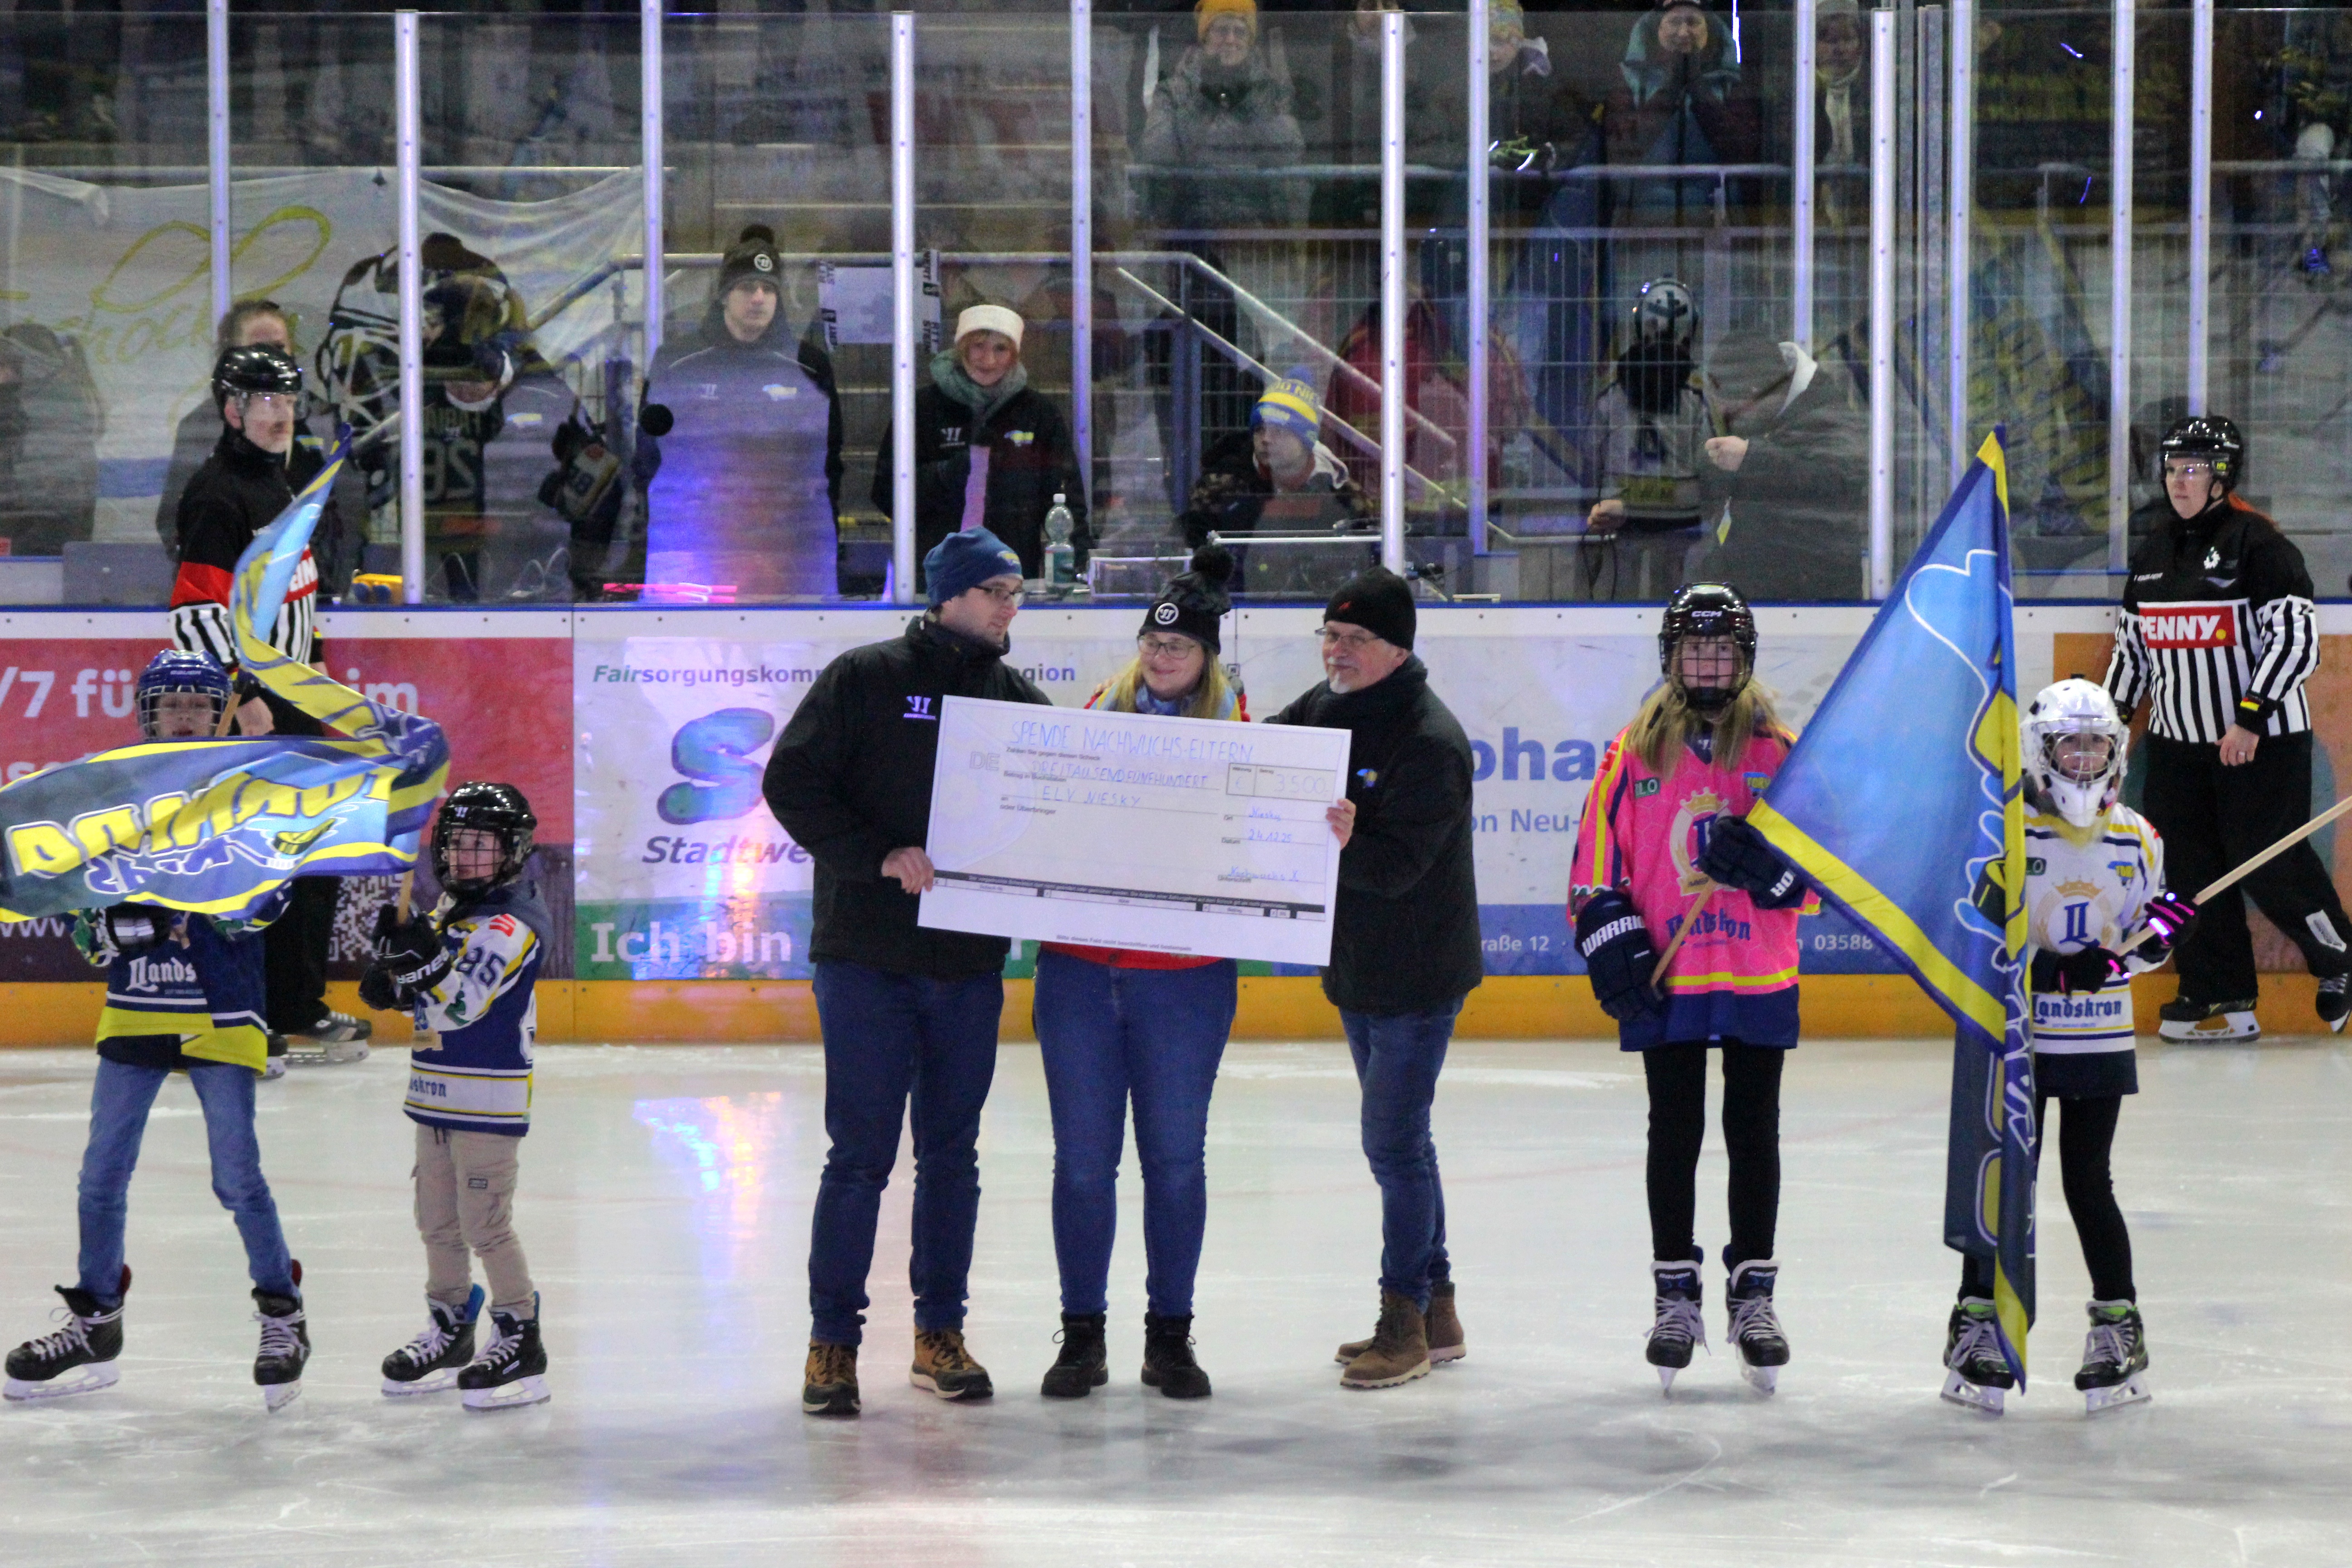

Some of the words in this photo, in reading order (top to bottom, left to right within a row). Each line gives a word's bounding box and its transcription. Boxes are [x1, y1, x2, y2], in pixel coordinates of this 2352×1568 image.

[1009, 720, 1071, 748] SPENDE
[1043, 786, 1075, 802] ELV
[1083, 791, 1141, 807] NIESKY
[642, 836, 813, 864] Stadtwe
[591, 921, 680, 962] Ich
[707, 921, 792, 963] bin
[1529, 936, 1549, 951] 12
